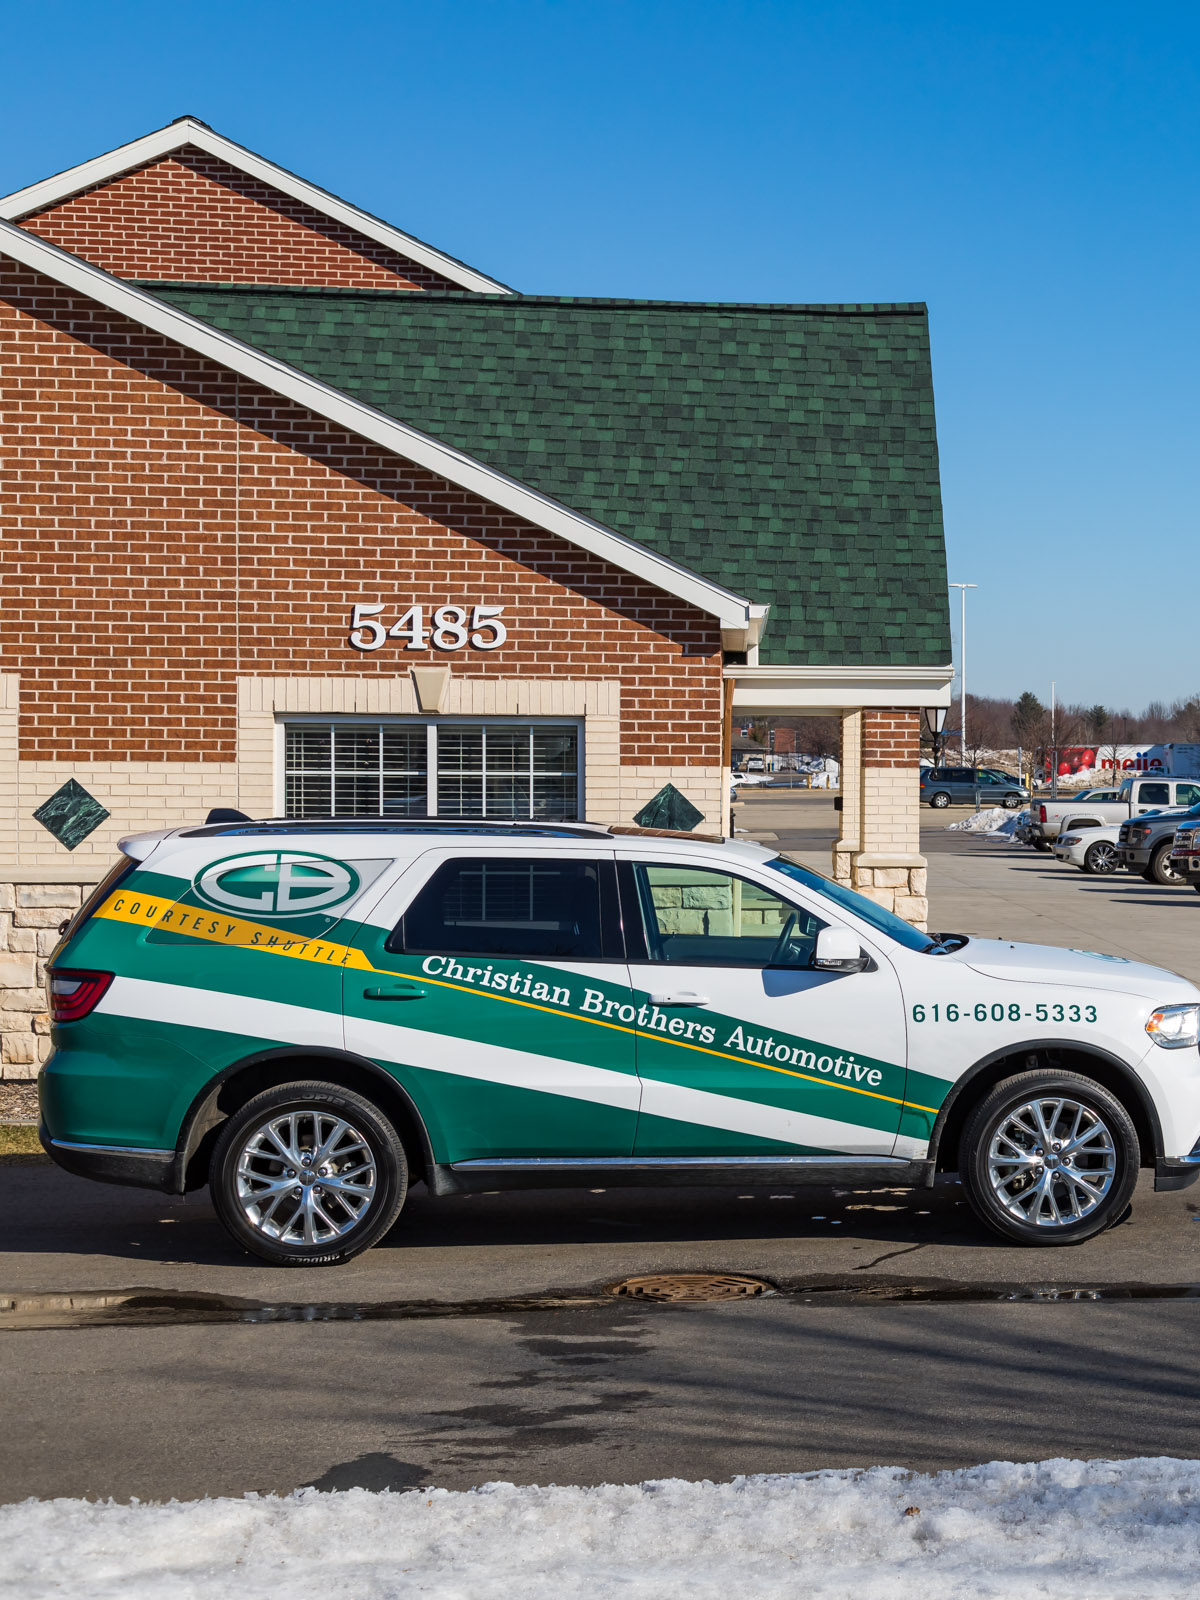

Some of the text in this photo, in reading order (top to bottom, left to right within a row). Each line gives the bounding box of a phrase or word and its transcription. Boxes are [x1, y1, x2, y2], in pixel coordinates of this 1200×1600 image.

[350, 604, 507, 650] 5485
[1101, 752, 1163, 771] meije
[113, 898, 353, 965] COURTESY SHUTTLE
[421, 955, 883, 1087] Christian Brothers Automotive
[912, 1003, 1098, 1023] 616-608-5333
